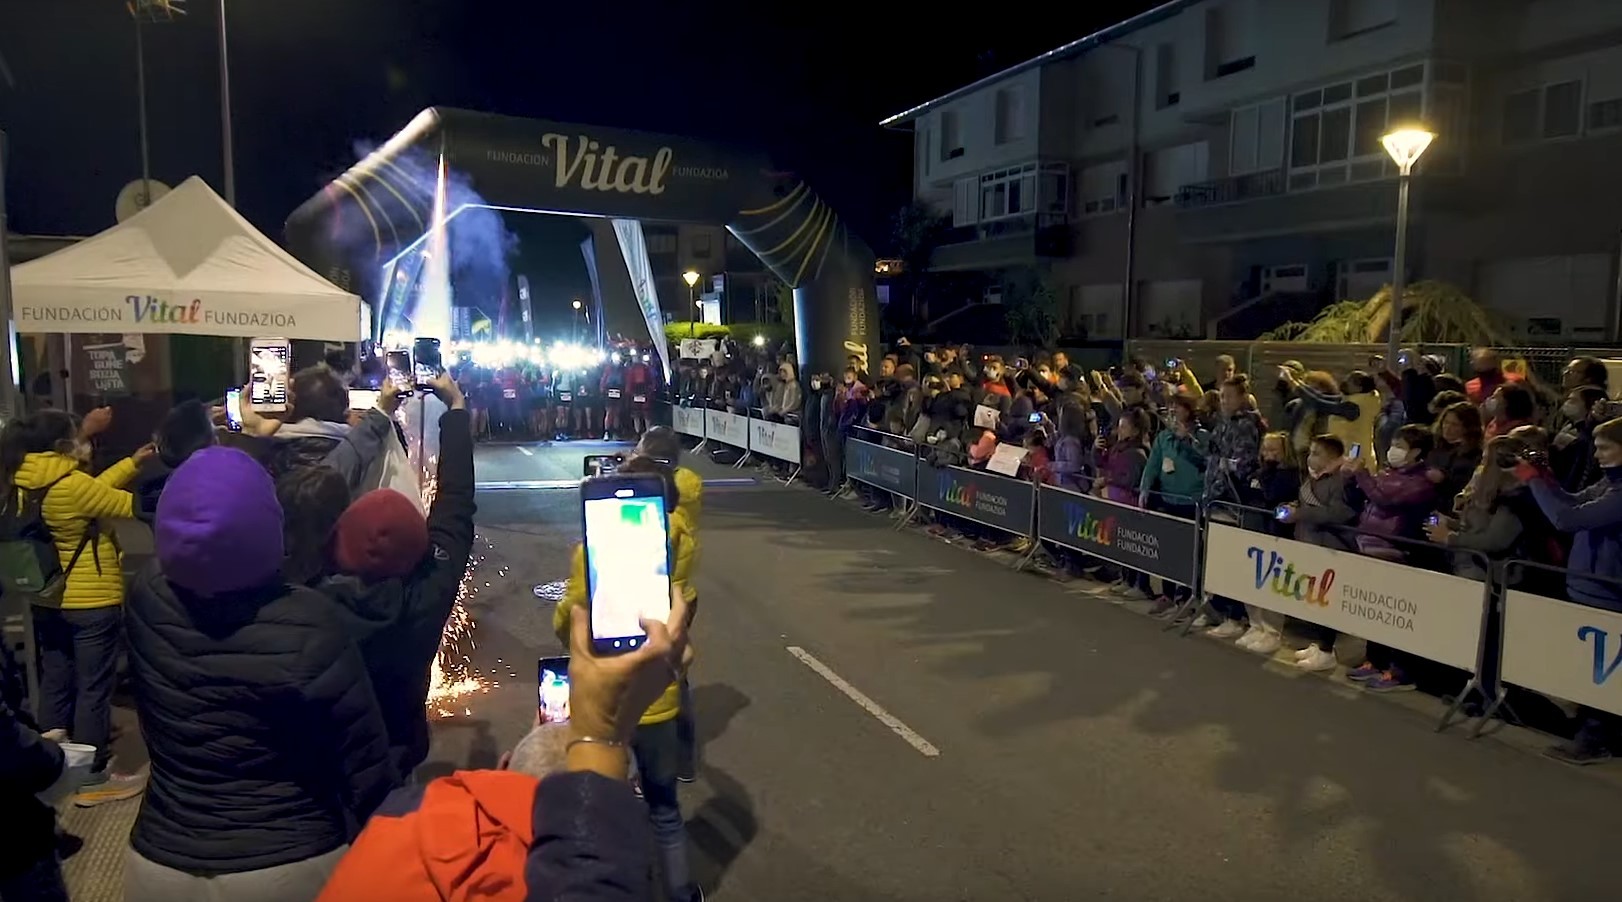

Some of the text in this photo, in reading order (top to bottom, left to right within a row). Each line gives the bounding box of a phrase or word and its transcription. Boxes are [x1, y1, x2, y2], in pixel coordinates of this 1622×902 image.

[541, 133, 673, 194] Vital
[126, 295, 201, 324] Vital
[204, 309, 297, 327] FUNDAZIOA
[1116, 539, 1159, 560] FUNDAZIOA
[1247, 546, 1335, 608] Vital
[1341, 600, 1415, 633] FUNDAZIOA
